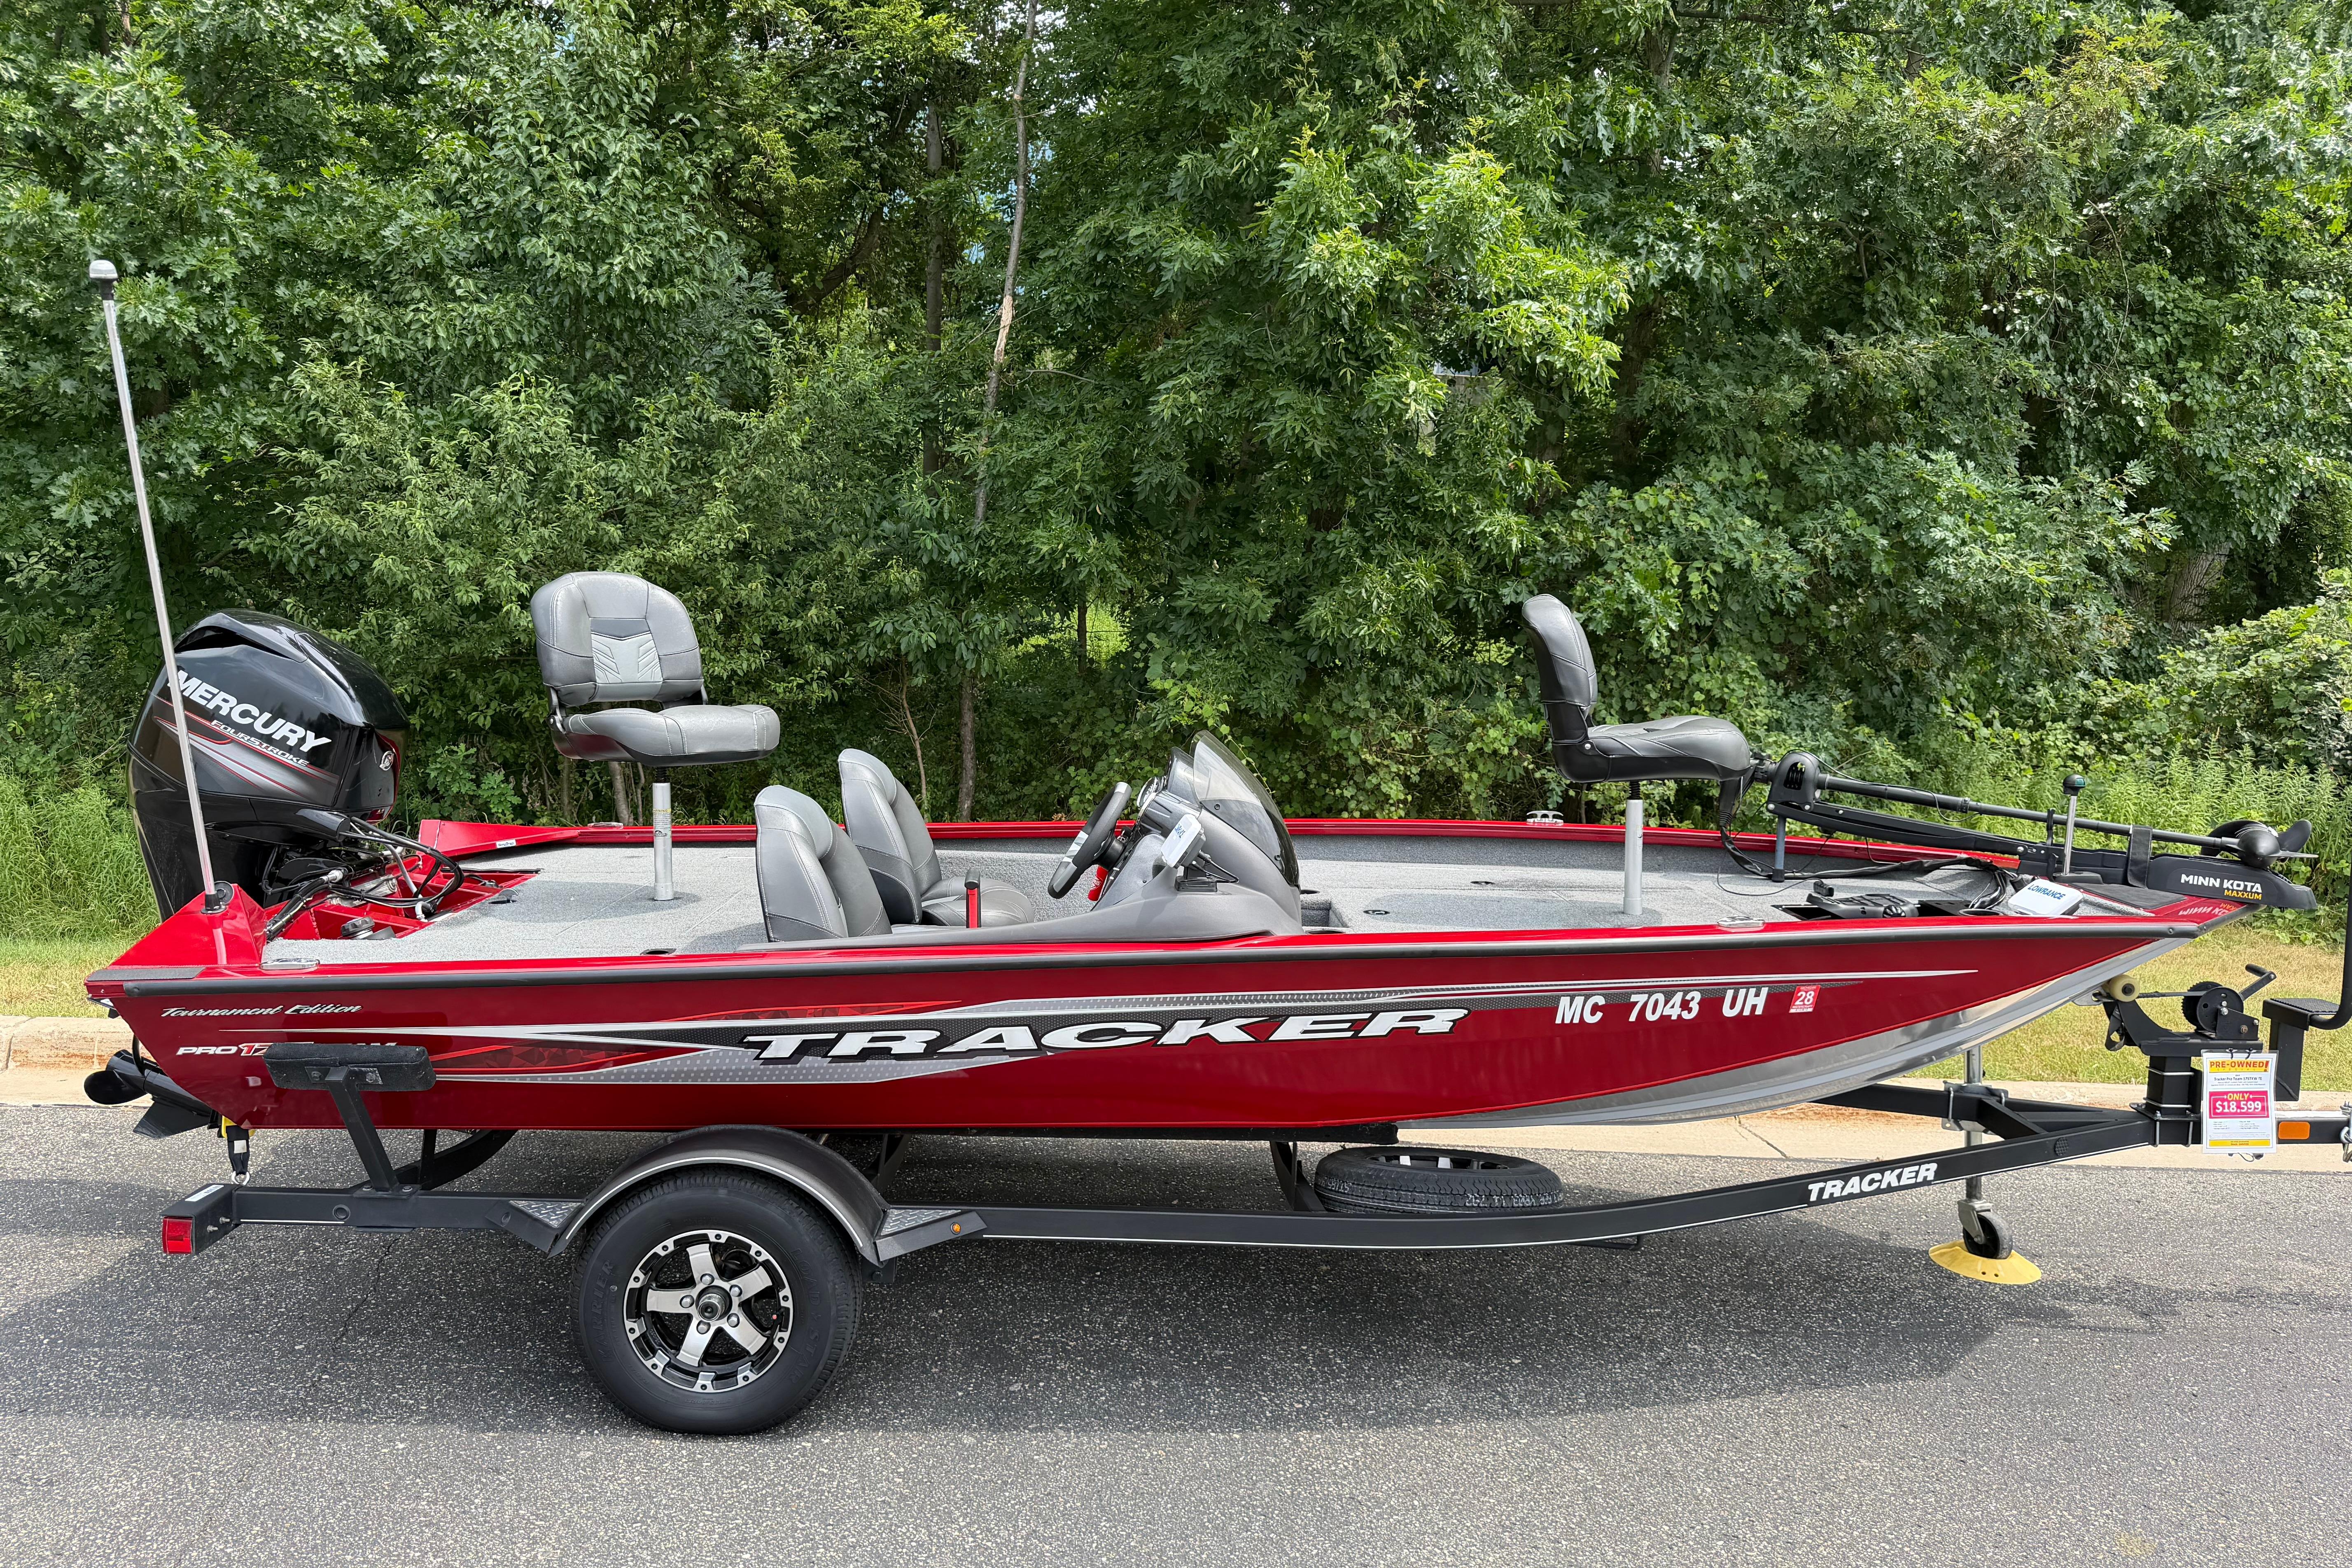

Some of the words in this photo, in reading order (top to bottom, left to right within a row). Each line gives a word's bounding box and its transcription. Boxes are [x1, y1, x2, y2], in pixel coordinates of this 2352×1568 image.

[168, 670, 331, 752] MERCURY
[210, 720, 310, 767] FOURSTROKE
[2028, 884, 2065, 900] LOWRANCE
[2181, 874, 2220, 887] MINN
[2223, 879, 2262, 893] KOTA
[2224, 889, 2262, 900] MAXXUM
[1555, 995, 1606, 1024] MC
[1629, 991, 1700, 1022] 7043
[1722, 987, 1769, 1017] UH
[1794, 991, 1815, 1005] 28
[161, 1005, 283, 1017] Tournament
[285, 1004, 362, 1015] Edition
[742, 1007, 1472, 1061] TRACKER
[176, 1045, 239, 1055] PRO
[2210, 1060, 2270, 1072] PRE-OWNED!
[1808, 1163, 1938, 1201] TRACKER
[591, 1259, 614, 1363] KARRIER
